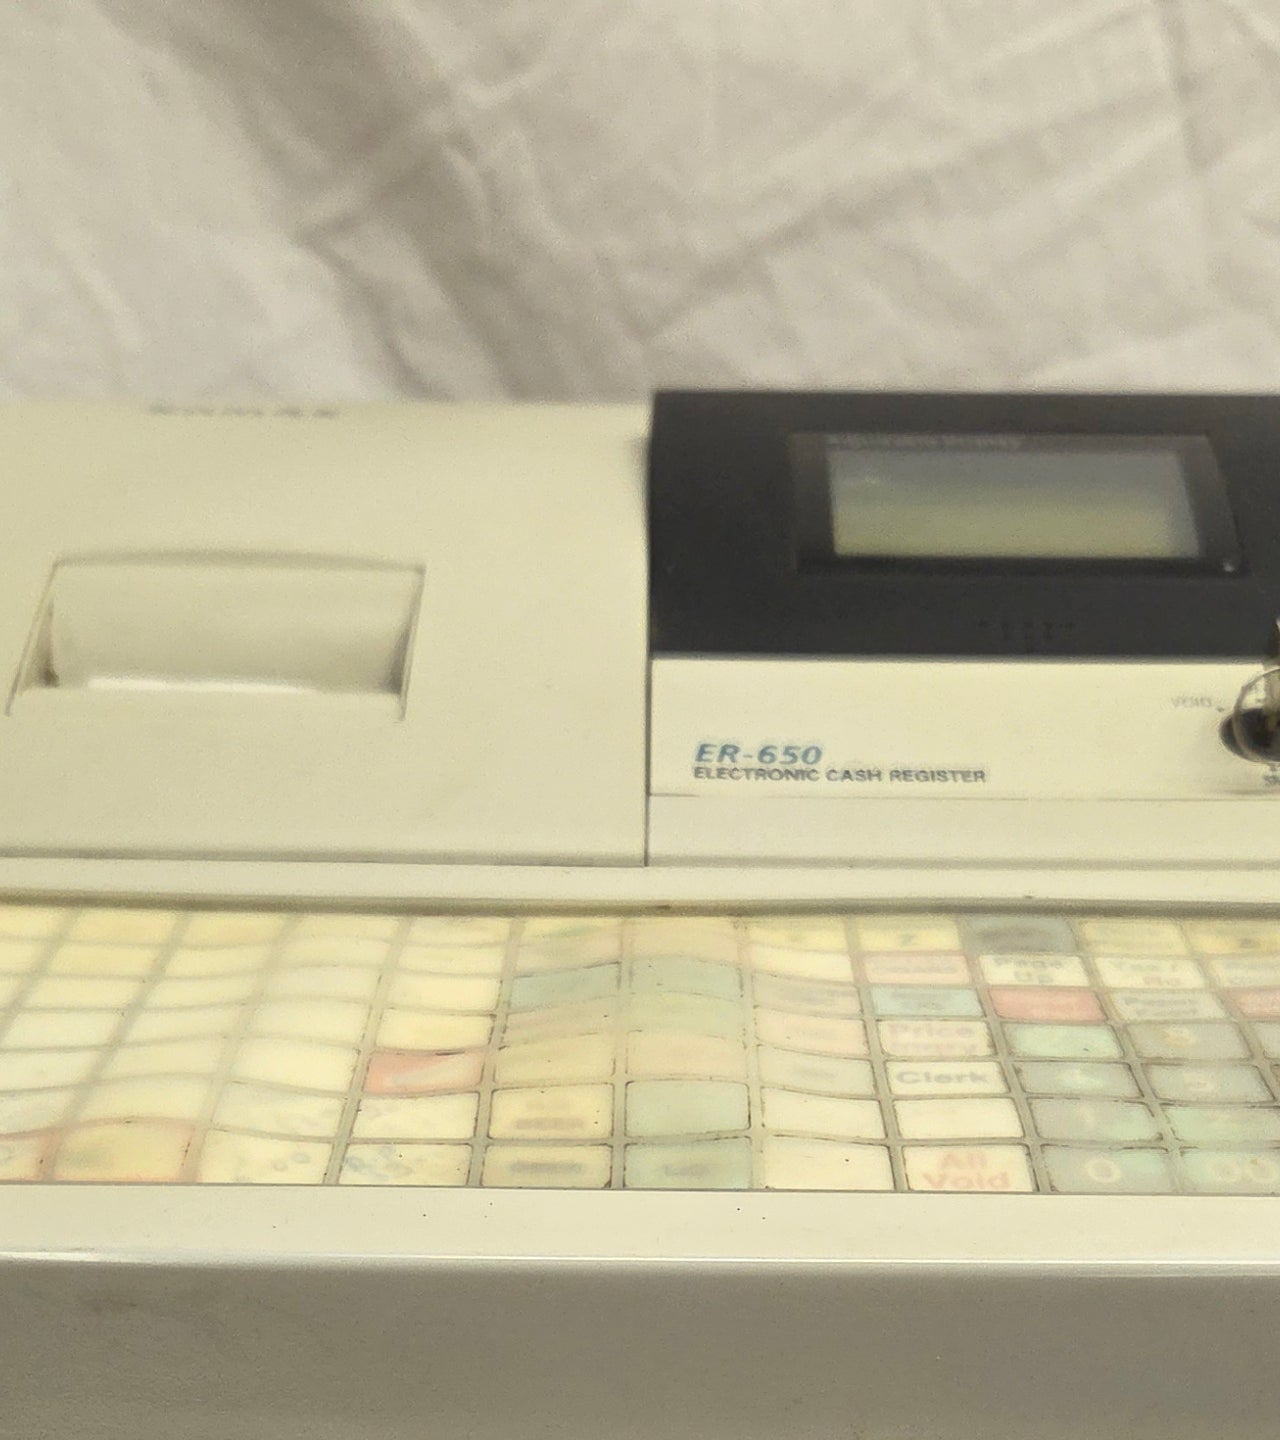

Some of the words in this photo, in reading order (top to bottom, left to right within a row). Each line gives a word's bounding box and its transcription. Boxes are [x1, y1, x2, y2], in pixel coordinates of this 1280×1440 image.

[694, 743, 823, 765] ER-650
[694, 766, 819, 782] ELECTRONIC
[826, 768, 882, 783] CASH
[889, 769, 986, 784] REGISTER
[896, 1070, 989, 1084] Clerk
[922, 1171, 1011, 1190] Void
